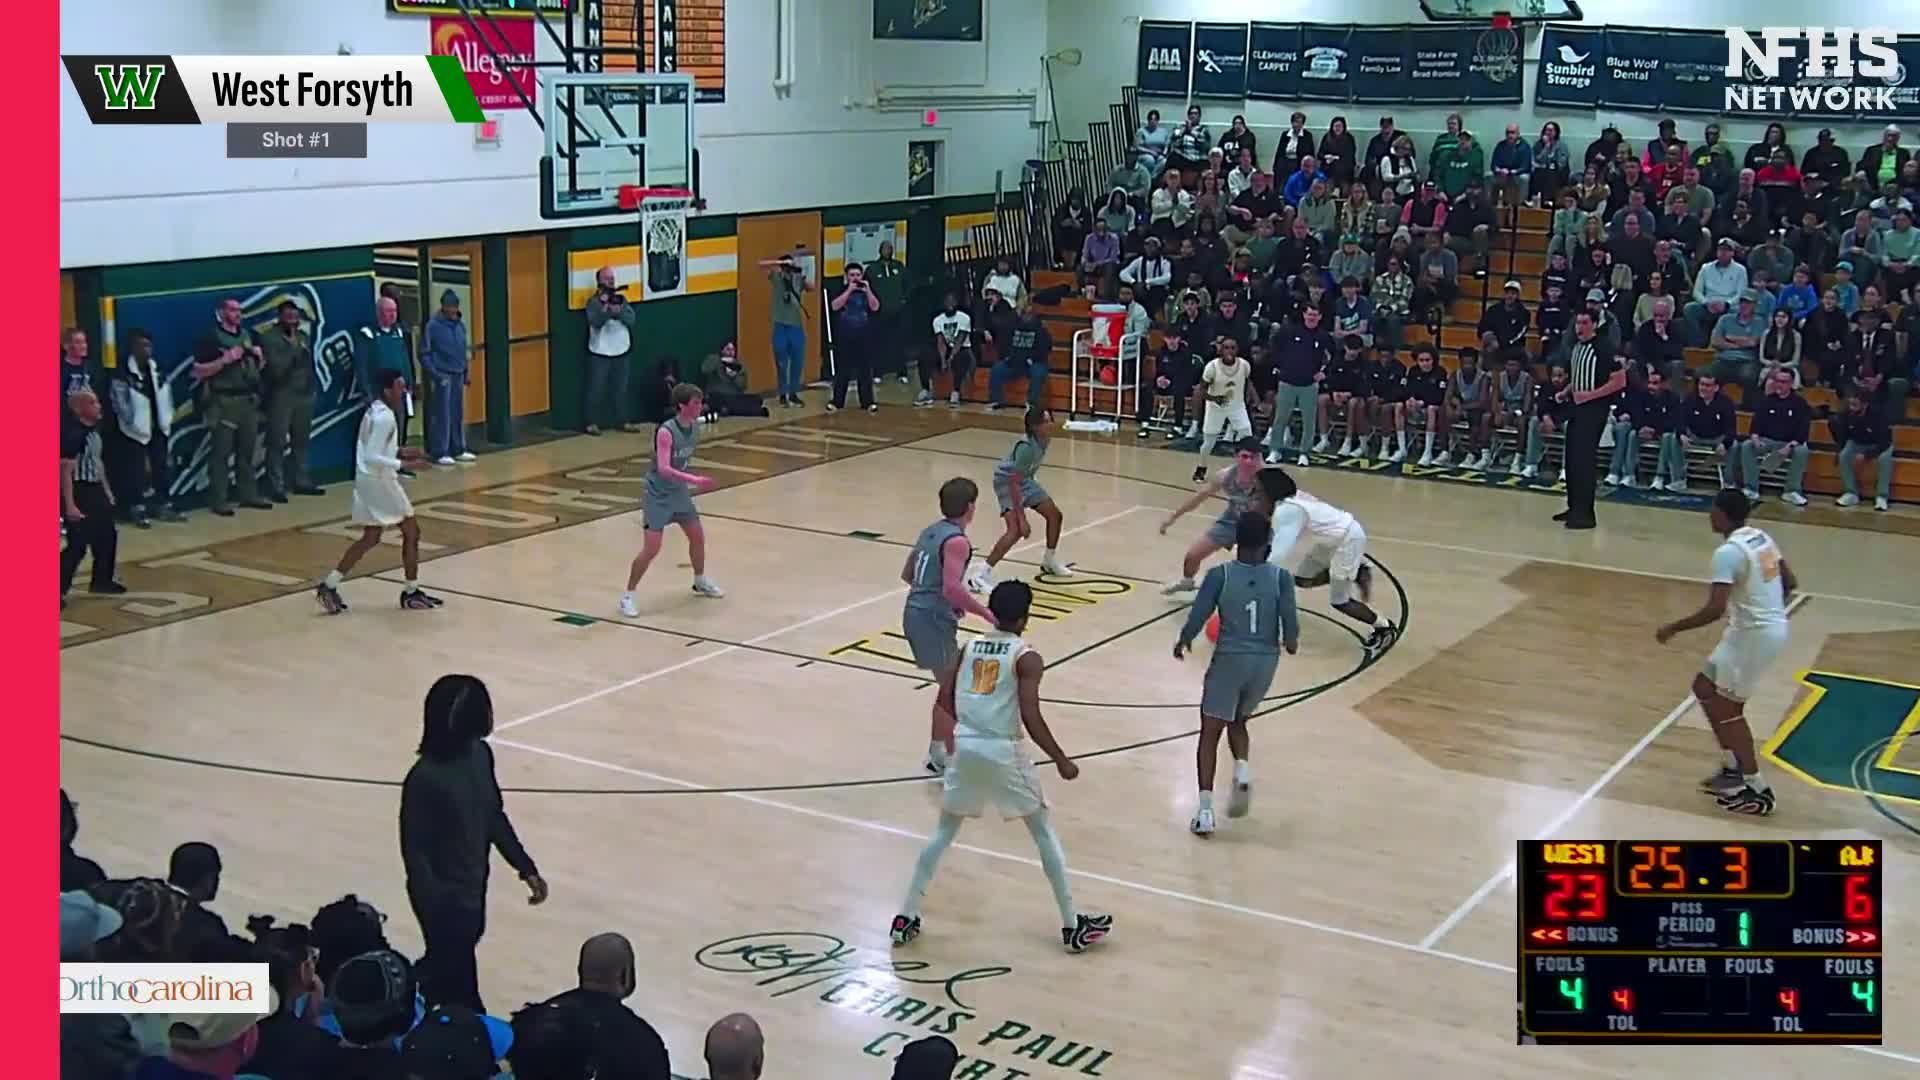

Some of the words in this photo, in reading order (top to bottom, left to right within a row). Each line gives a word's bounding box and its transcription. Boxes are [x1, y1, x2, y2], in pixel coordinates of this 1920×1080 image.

[1149, 48, 1181, 66] AAA
[1252, 51, 1297, 62] CLEMMONS
[1417, 52, 1437, 60] State
[1606, 57, 1630, 68] Blue
[1633, 59, 1659, 70] Wolf
[1258, 62, 1290, 72] CARPET
[1360, 65, 1384, 74] Family
[1412, 71, 1431, 79] Brad
[1545, 63, 1595, 77] Sunbird
[1613, 70, 1649, 80] Dental
[1547, 76, 1591, 89] Storage
[1245, 600, 1257, 633] 1
[973, 641, 1011, 655] TITANS
[1543, 844, 1605, 864] WEST
[1545, 873, 1606, 920] 23
[1845, 875, 1873, 920] 6
[1671, 902, 1703, 914] POSS
[1658, 916, 1716, 933] PERIOD
[1738, 911, 1749, 947] 1
[1567, 926, 1619, 942] BONUS
[1792, 928, 1845, 944] BONUS
[1535, 956, 1585, 972] FOULS
[1648, 957, 1706, 973] PLAYER
[1725, 958, 1774, 974] FOULS
[1824, 959, 1875, 975] FOULS
[1559, 976, 1584, 1011] 4
[1613, 988, 1632, 1012] 4
[1779, 989, 1797, 1013] 4
[1851, 979, 1874, 1013] 4
[819, 979, 976, 1034] CHRIS
[977, 1019, 1114, 1076] PAUL
[1607, 1015, 1639, 1031] TOL
[1773, 1016, 1804, 1032] TOL
